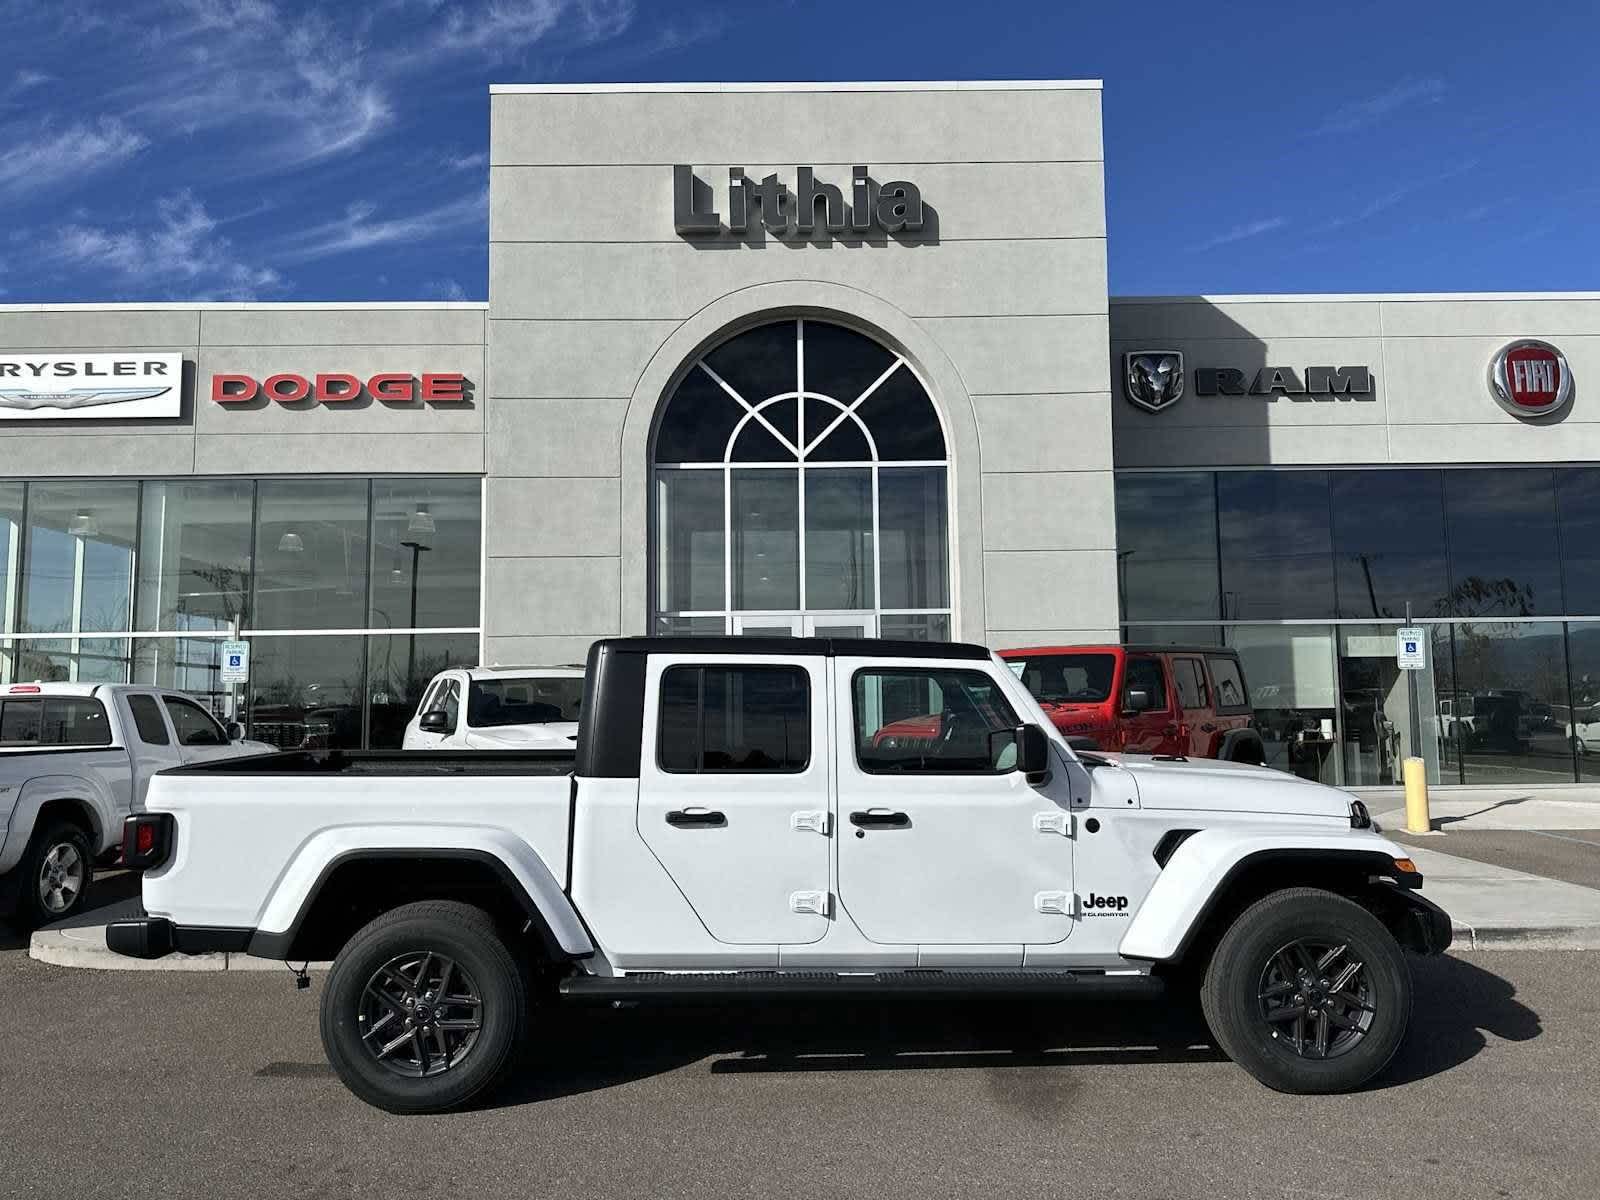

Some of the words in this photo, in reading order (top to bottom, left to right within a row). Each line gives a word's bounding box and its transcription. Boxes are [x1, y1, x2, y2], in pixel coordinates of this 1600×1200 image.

[672, 164, 925, 233] Lithia
[211, 373, 465, 401] DODGE
[1195, 366, 1372, 396] RAM
[1512, 360, 1555, 393] FIAT
[1083, 893, 1128, 911] Jeep
